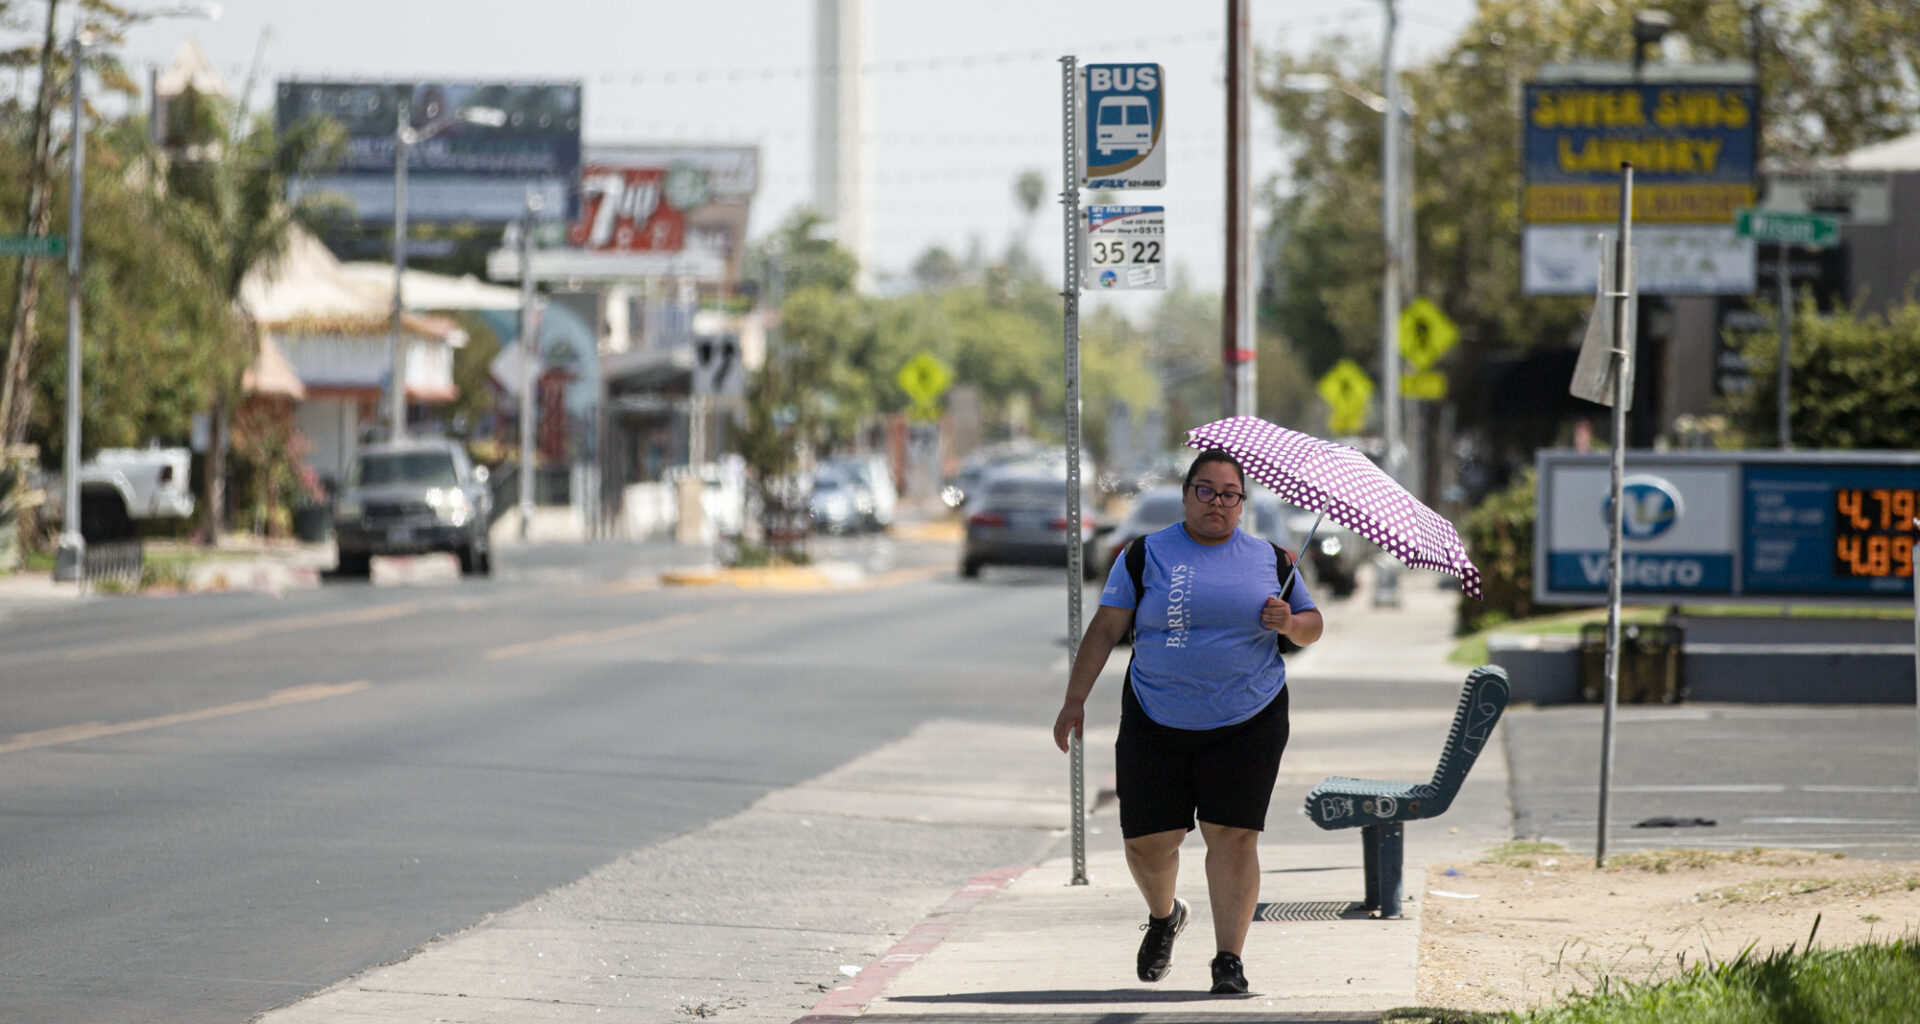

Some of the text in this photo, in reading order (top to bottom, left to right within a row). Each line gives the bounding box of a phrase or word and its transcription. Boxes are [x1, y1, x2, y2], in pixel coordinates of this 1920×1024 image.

[1091, 67, 1157, 91] BUS
[1093, 241, 1160, 264] 35 22
[1165, 564, 1188, 649] BARROWS
